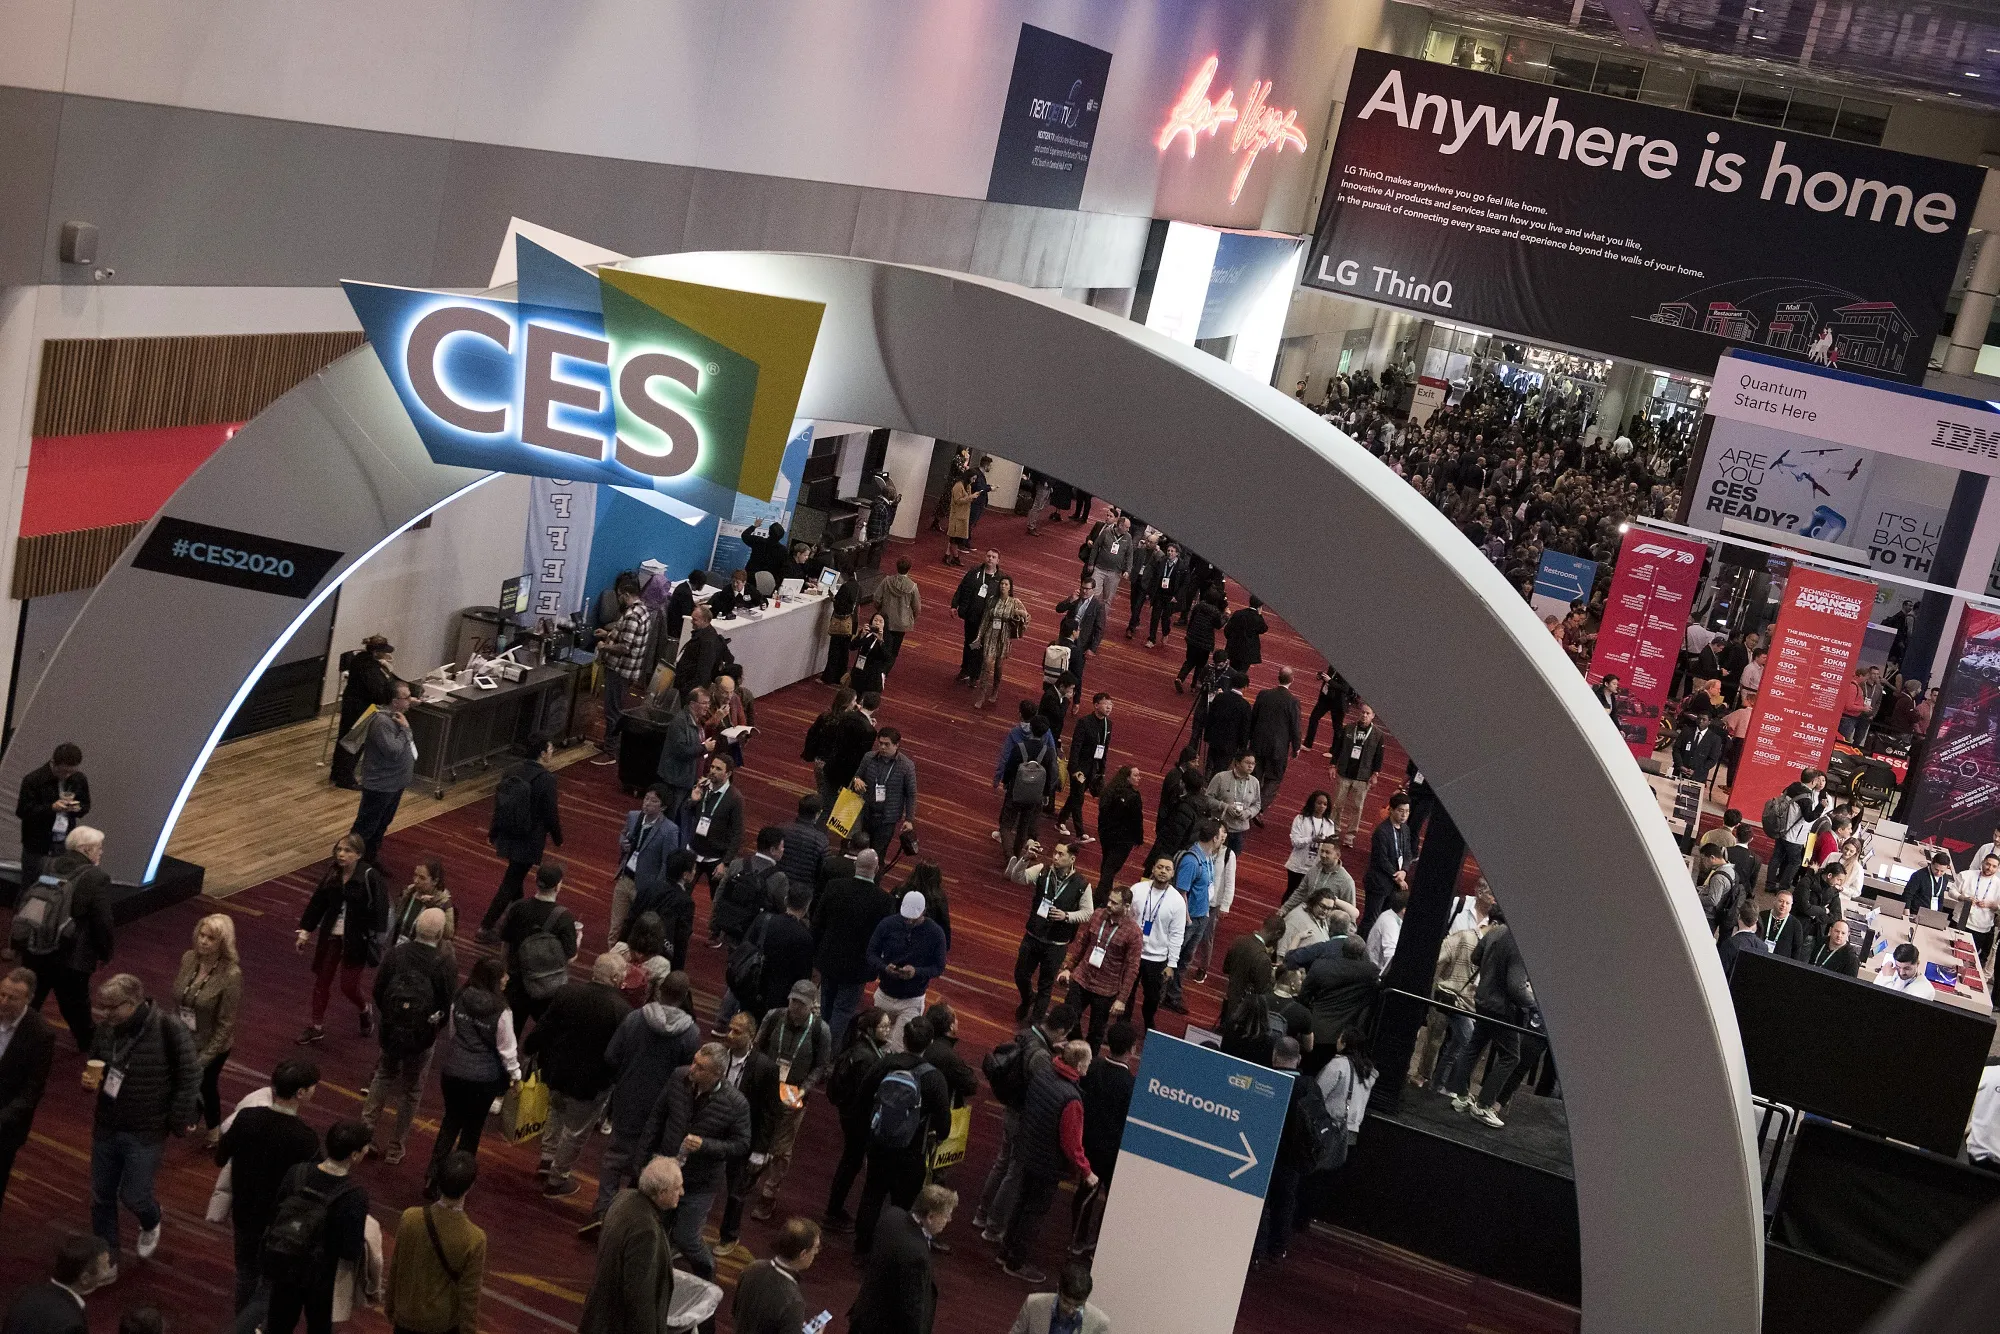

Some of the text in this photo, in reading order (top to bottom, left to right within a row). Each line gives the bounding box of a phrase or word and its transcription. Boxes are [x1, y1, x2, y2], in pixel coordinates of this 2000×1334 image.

[1357, 70, 1957, 235] Anywhere is home
[1344, 164, 1549, 216] LG ThinQ makes anywhere you go feel like home.
[1342, 178, 1643, 252] Innovative AI products and services learn how you live and what you like,
[1336, 192, 1705, 279] in the pursuit of connecting every space and experience beyond the walls of your home.
[1318, 254, 1453, 309] LG ThinQ
[1713, 310, 1743, 318] Restaurant
[406, 306, 700, 477] CES
[1417, 388, 1435, 399] Exit
[1740, 374, 1807, 400] Quantum
[1734, 393, 1817, 422] Starts Here
[1931, 420, 2000, 459] IBM
[1719, 447, 1768, 471] ARE
[1718, 462, 1764, 485] YOU
[1711, 479, 1758, 502] CES
[1706, 495, 1800, 530] READY?
[1878, 511, 1942, 539] IT'S LI
[1631, 543, 1676, 559] F1
[1872, 528, 1938, 557] BACK
[172, 538, 295, 578] #CES2020
[1868, 545, 1932, 574] TO TH
[1543, 565, 1579, 580] Restrooms
[1796, 592, 1861, 613] ADVANCED
[1799, 586, 1863, 606] TECHNOLOGICALLY
[1795, 600, 1834, 615] SPORT
[1833, 611, 1858, 620] WORLD
[1784, 636, 1807, 647] 35KM
[1799, 631, 1830, 643] BROADCAST
[1831, 638, 1853, 648] CENTRE
[1781, 647, 1800, 656] 150+
[1823, 657, 1847, 668] 10KM
[1773, 674, 1796, 684] 400K
[1820, 671, 1843, 681] 40TB
[1769, 688, 1785, 696] 90+
[1763, 712, 1783, 721] 300+
[1760, 723, 1781, 733] 16GB
[1792, 731, 1825, 744] 231MPH
[1951, 734, 1972, 746] TARGET
[1965, 733, 1988, 747] CARBON
[1753, 750, 1780, 761] 480GB
[1941, 747, 1971, 762] FOOTPRINT
[1950, 786, 1999, 809] NEW GENERATION
[1954, 790, 1975, 801] TALKING
[1974, 796, 1989, 805] FANS
[828, 816, 849, 836] Nikon
[1228, 1075, 1246, 1089] CES
[1148, 1078, 1241, 1122] Restrooms
[513, 1121, 546, 1140] Niko
[935, 1151, 964, 1167] Nikon
